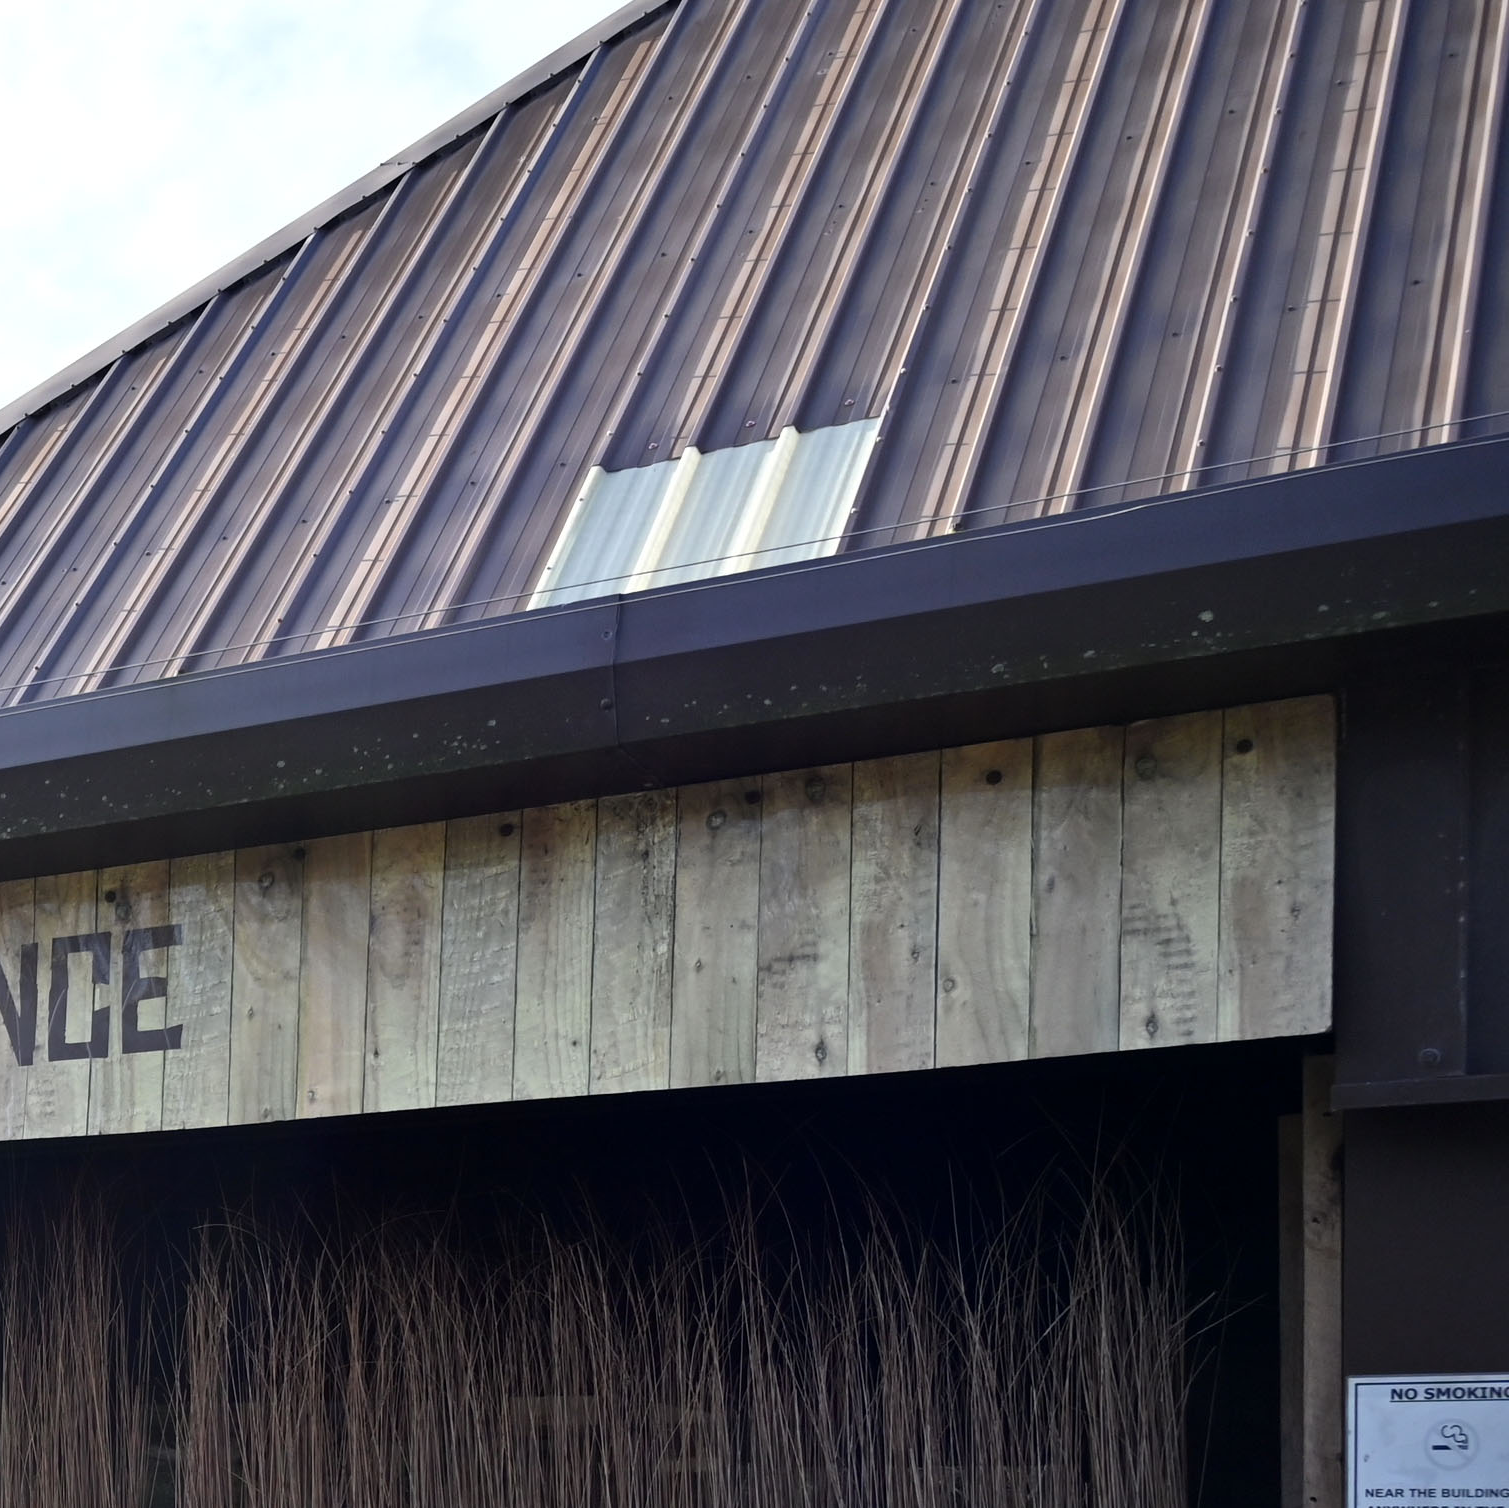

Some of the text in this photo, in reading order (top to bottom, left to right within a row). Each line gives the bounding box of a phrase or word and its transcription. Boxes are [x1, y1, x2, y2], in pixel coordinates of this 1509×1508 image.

[1390, 1388, 1417, 1400] NO
[1365, 1489, 1404, 1498] NEAR
[1409, 1489, 1436, 1498] THE
